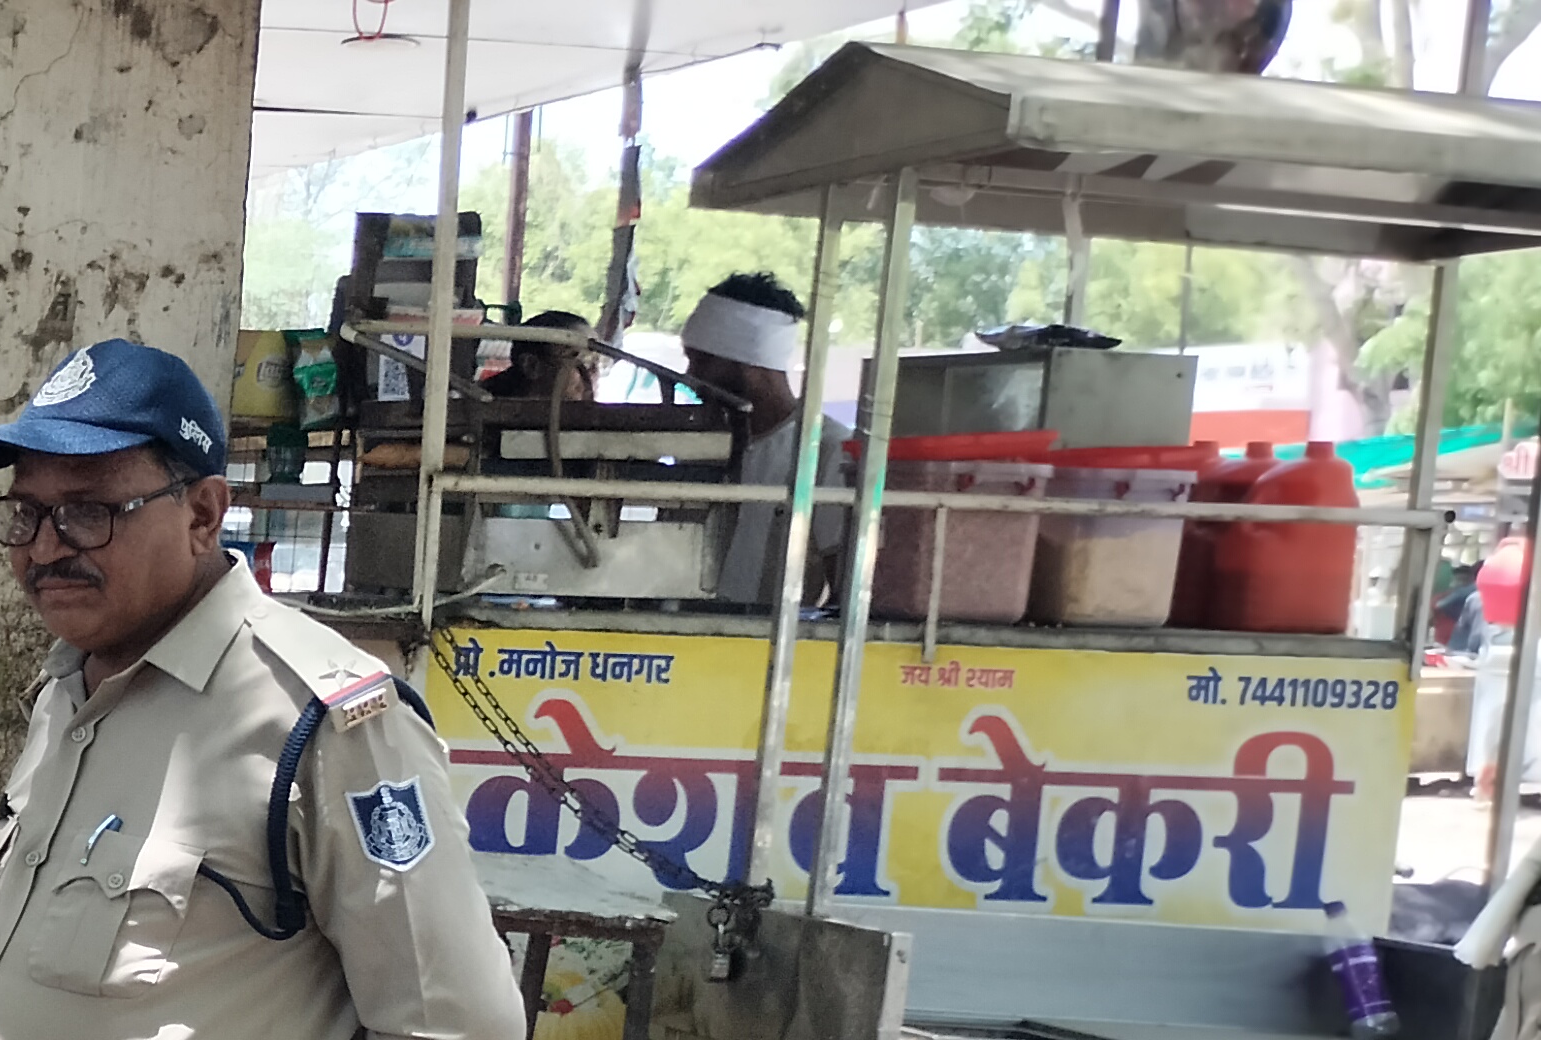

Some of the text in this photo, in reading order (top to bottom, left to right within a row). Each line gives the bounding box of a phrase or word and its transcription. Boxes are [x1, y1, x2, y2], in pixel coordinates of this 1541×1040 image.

[589, 652, 674, 684] धनगर
[899, 661, 1015, 689] जय श्री श्याम
[1187, 667, 1399, 710] मो. 7441109328
[449, 698, 1355, 909] केशव बेकरी
